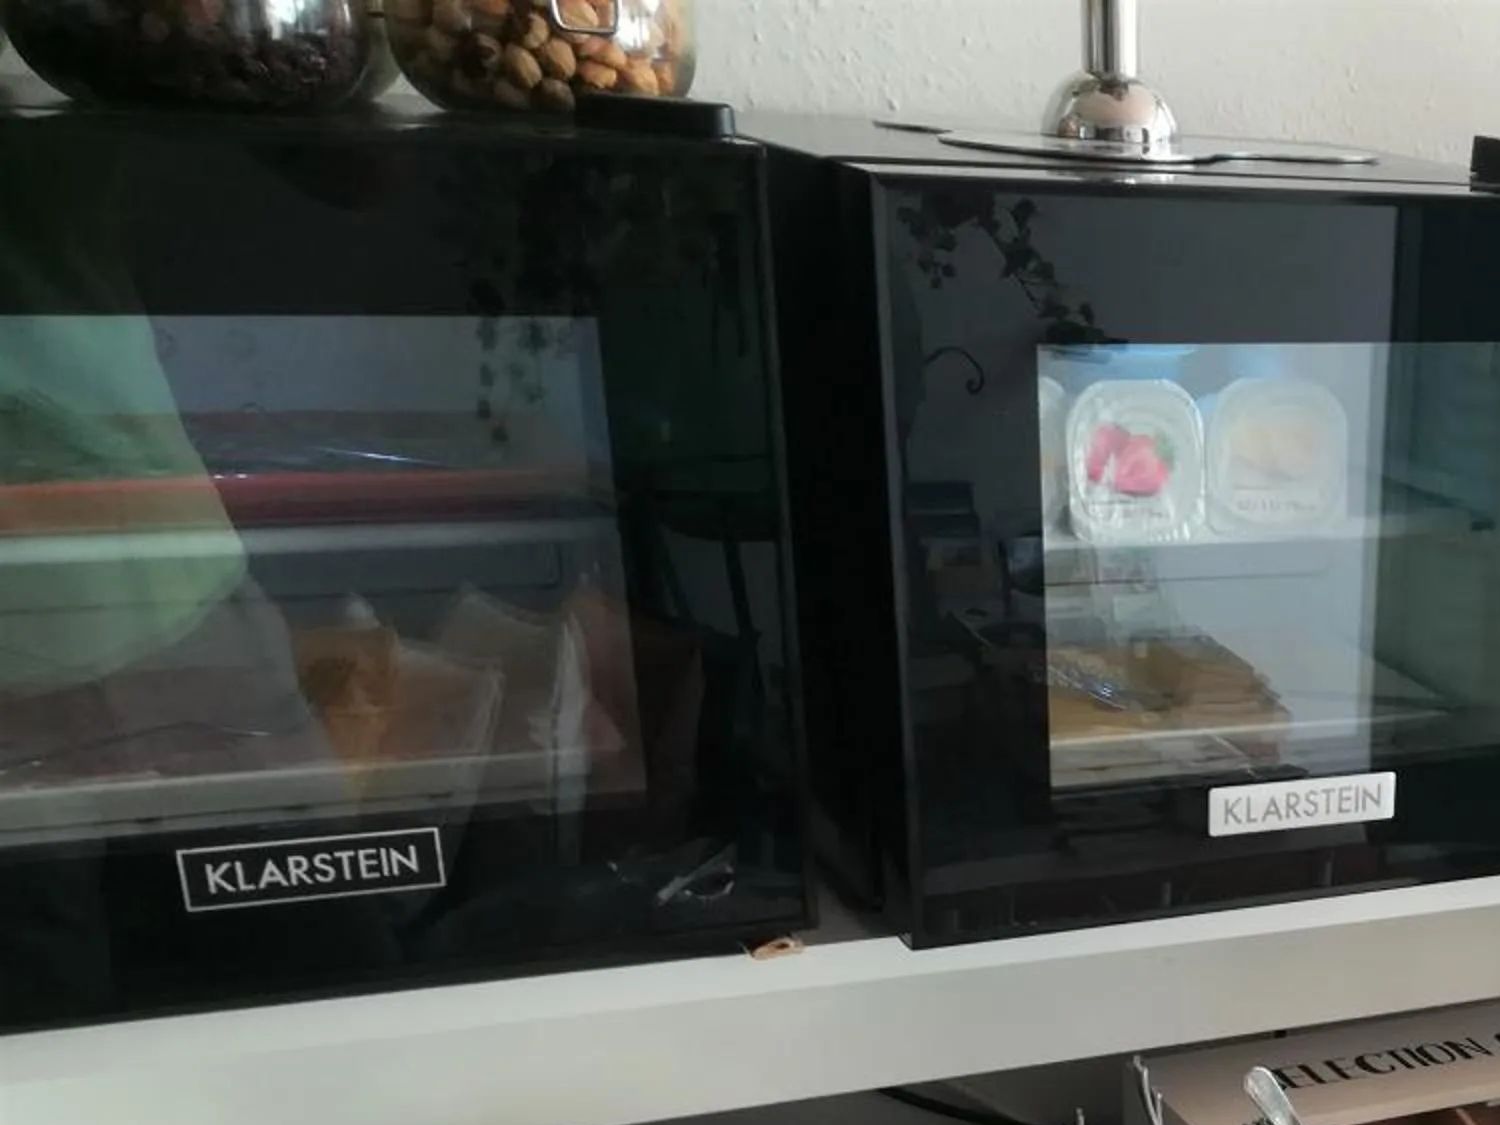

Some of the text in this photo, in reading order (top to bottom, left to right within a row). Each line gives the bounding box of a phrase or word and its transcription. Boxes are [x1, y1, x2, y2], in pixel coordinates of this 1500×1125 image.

[1222, 781, 1382, 825] KLARSTEIN
[203, 845, 421, 896] KLARSTEIN
[1274, 1036, 1495, 1091] ELECTION
